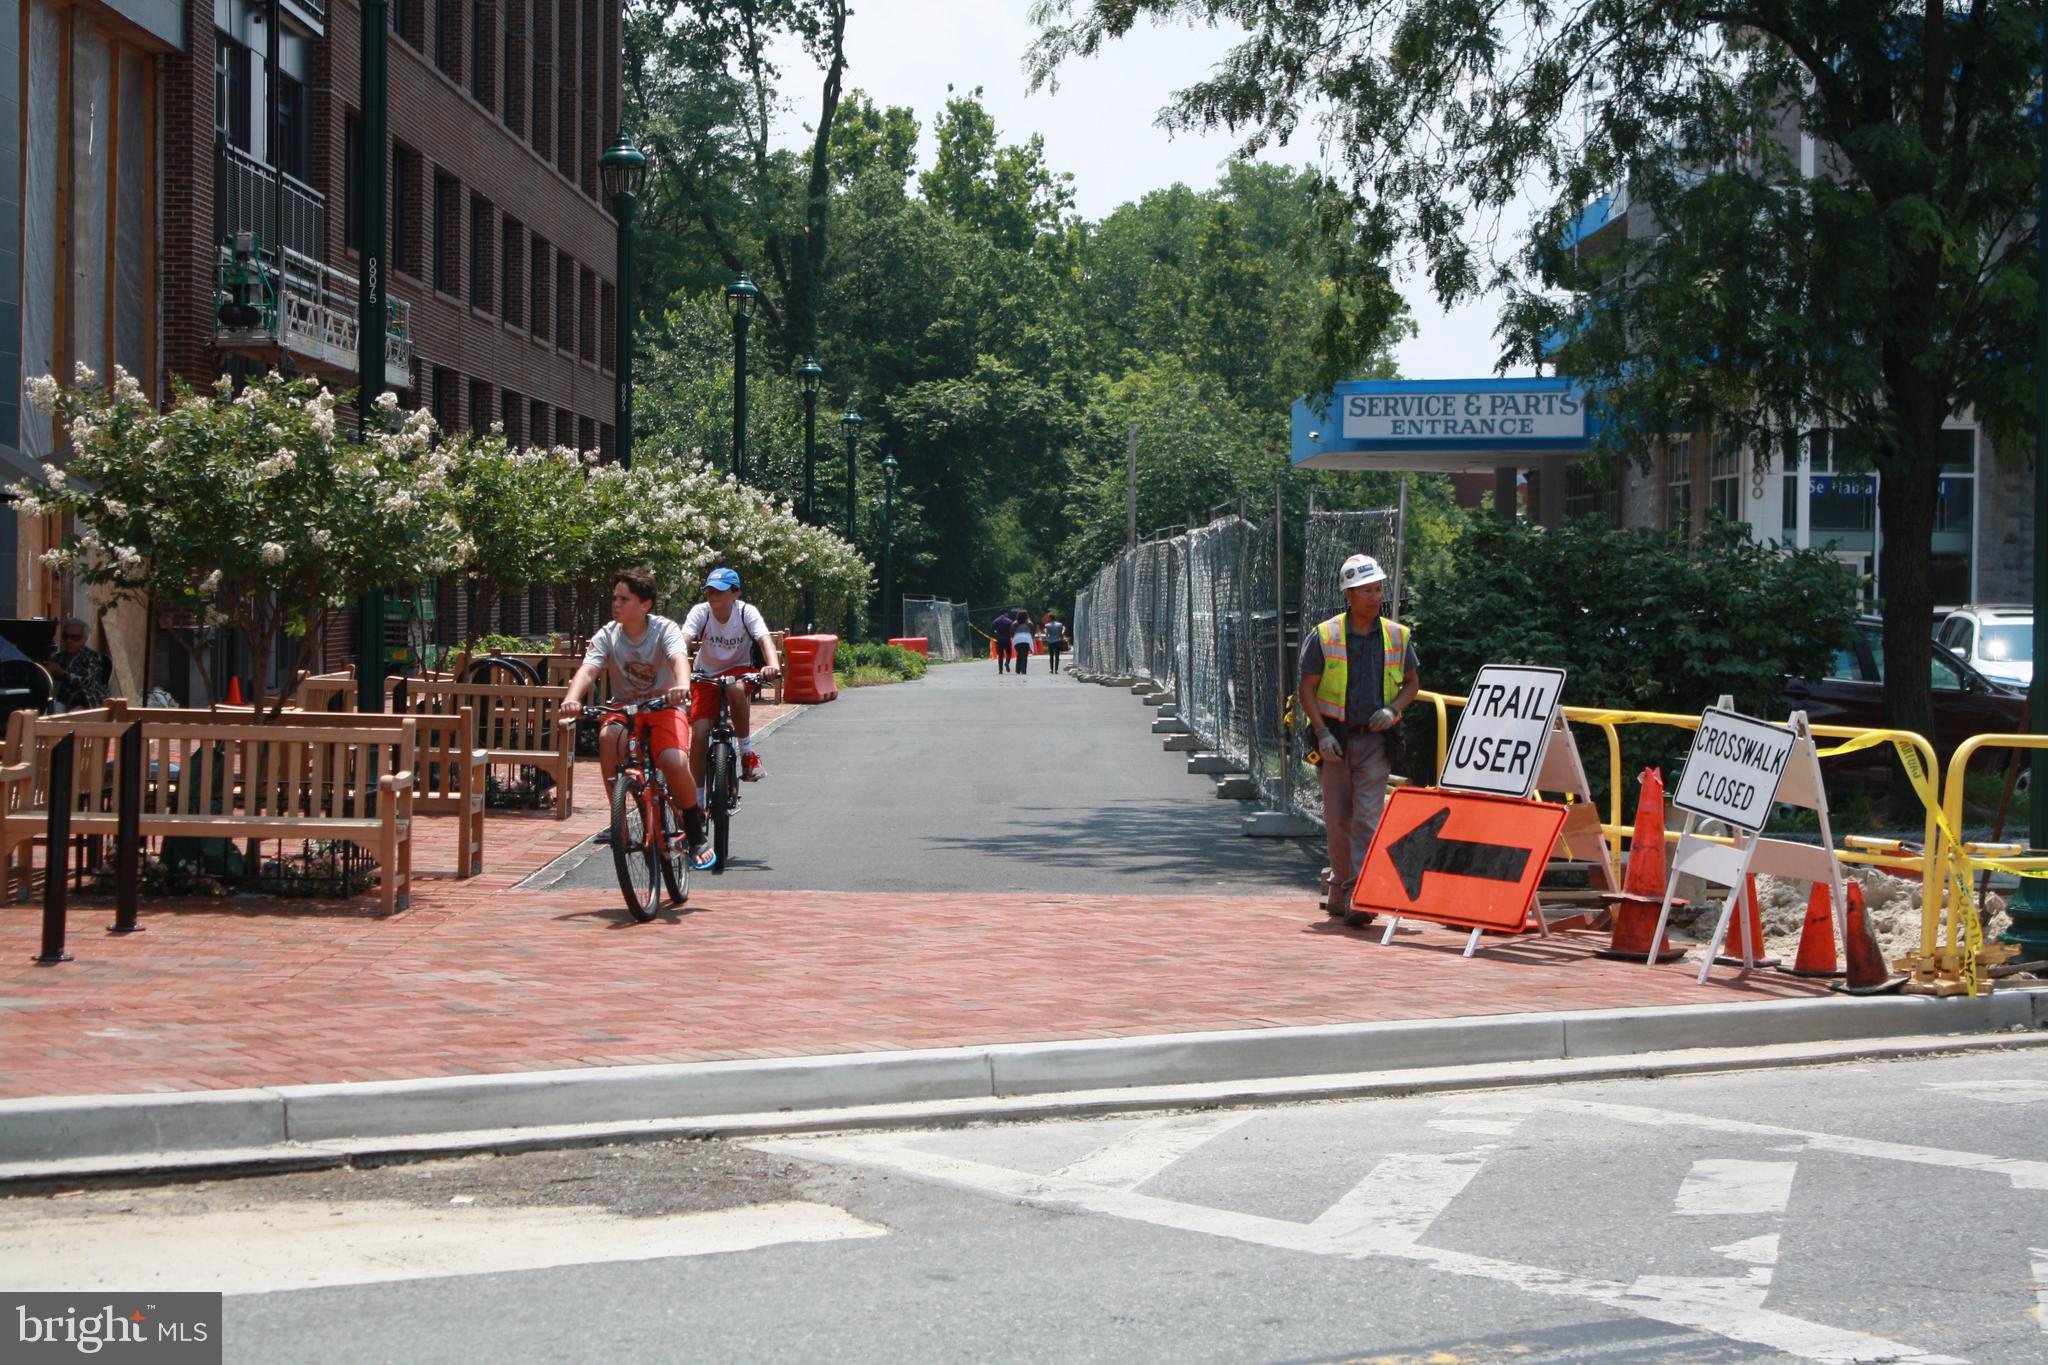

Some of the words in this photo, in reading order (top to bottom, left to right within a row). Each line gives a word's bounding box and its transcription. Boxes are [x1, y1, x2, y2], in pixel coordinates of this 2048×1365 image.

[369, 257, 377, 304] 09075
[1349, 395, 1456, 417] SERVICE
[1463, 394, 1483, 417] &
[1489, 394, 1580, 416] PARTS
[1391, 418, 1534, 435] ENTRANCE
[1472, 684, 1546, 721] TRAIL
[1455, 735, 1531, 775] USER
[1696, 725, 1786, 776] CROSSWALK
[1696, 770, 1755, 811] CLOSED
